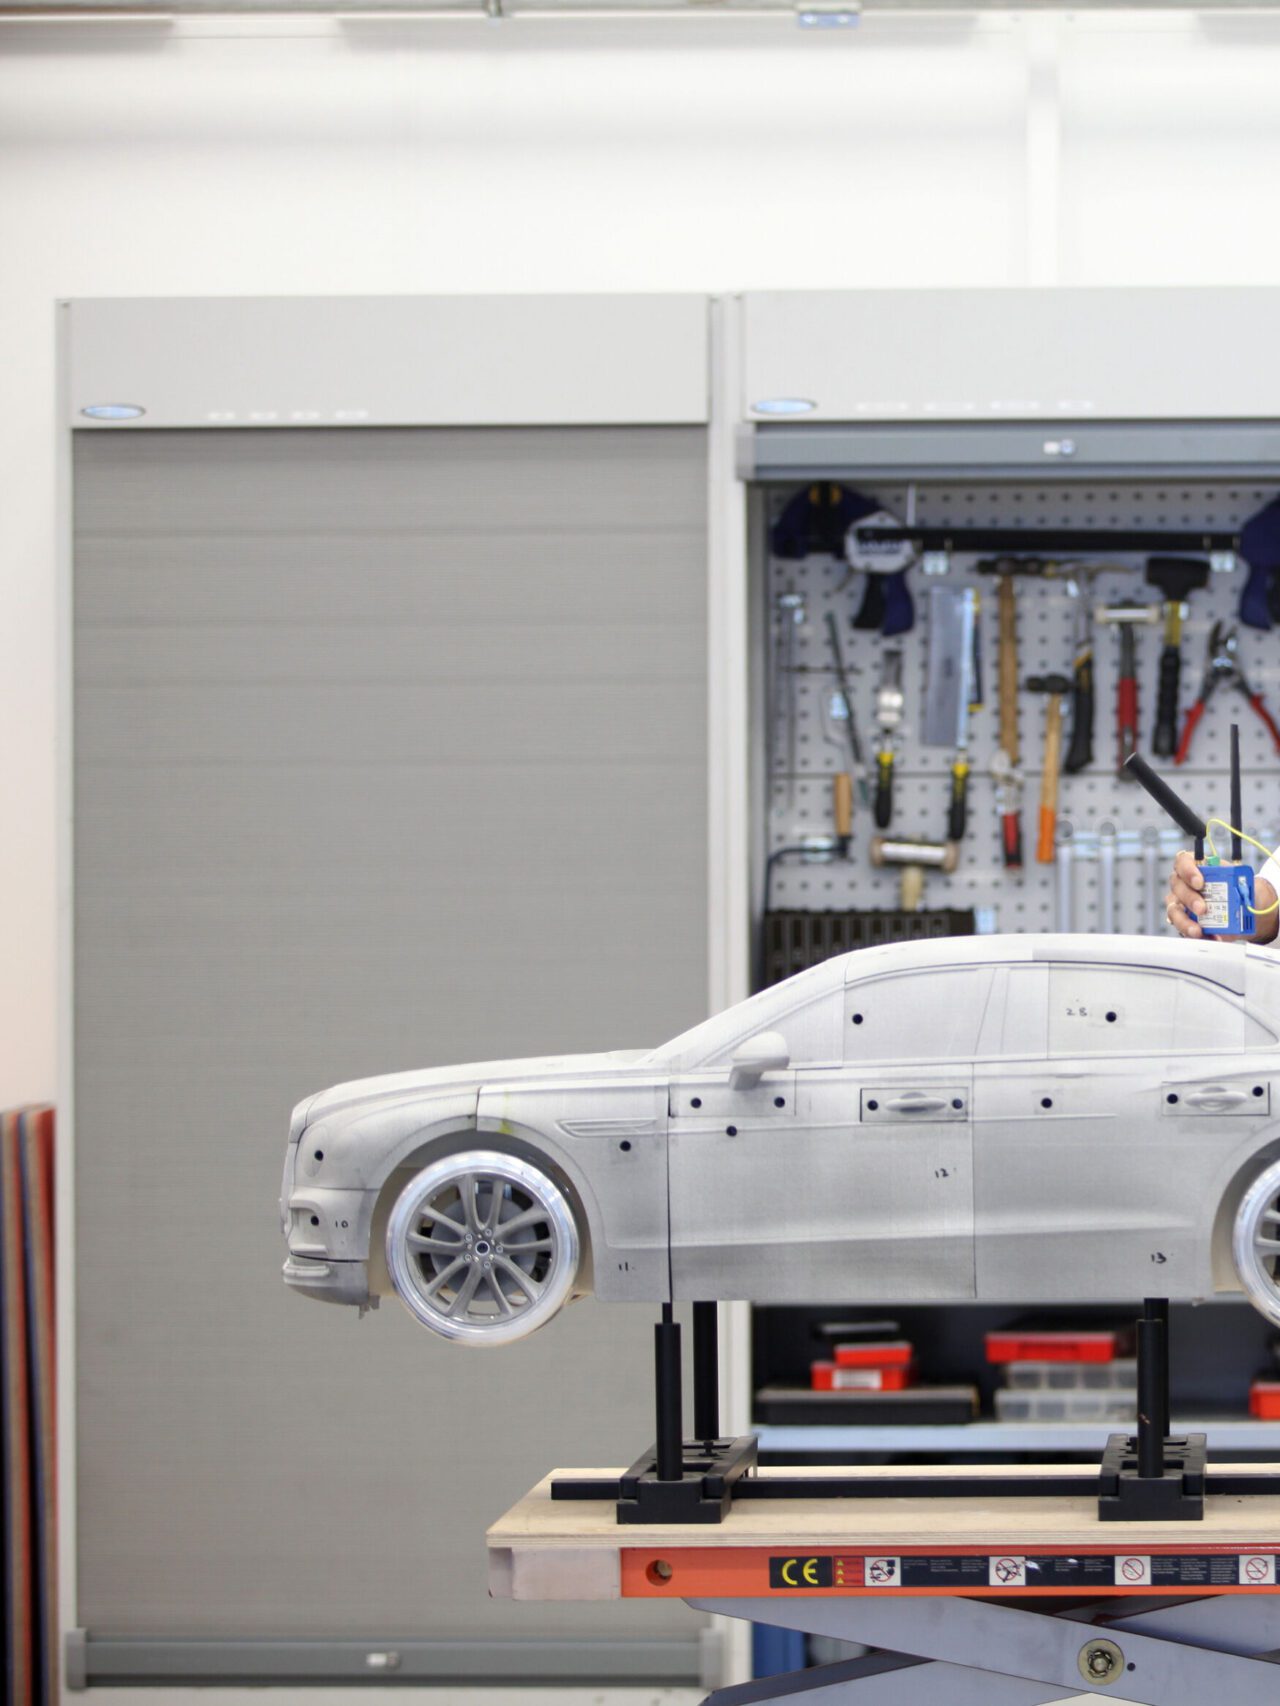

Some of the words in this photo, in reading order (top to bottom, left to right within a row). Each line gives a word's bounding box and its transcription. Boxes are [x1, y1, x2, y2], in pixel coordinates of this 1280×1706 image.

[934, 1167, 949, 1179] 12
[335, 1219, 349, 1229] 10
[1150, 1251, 1167, 1264] 13
[781, 1558, 819, 1586] CE
